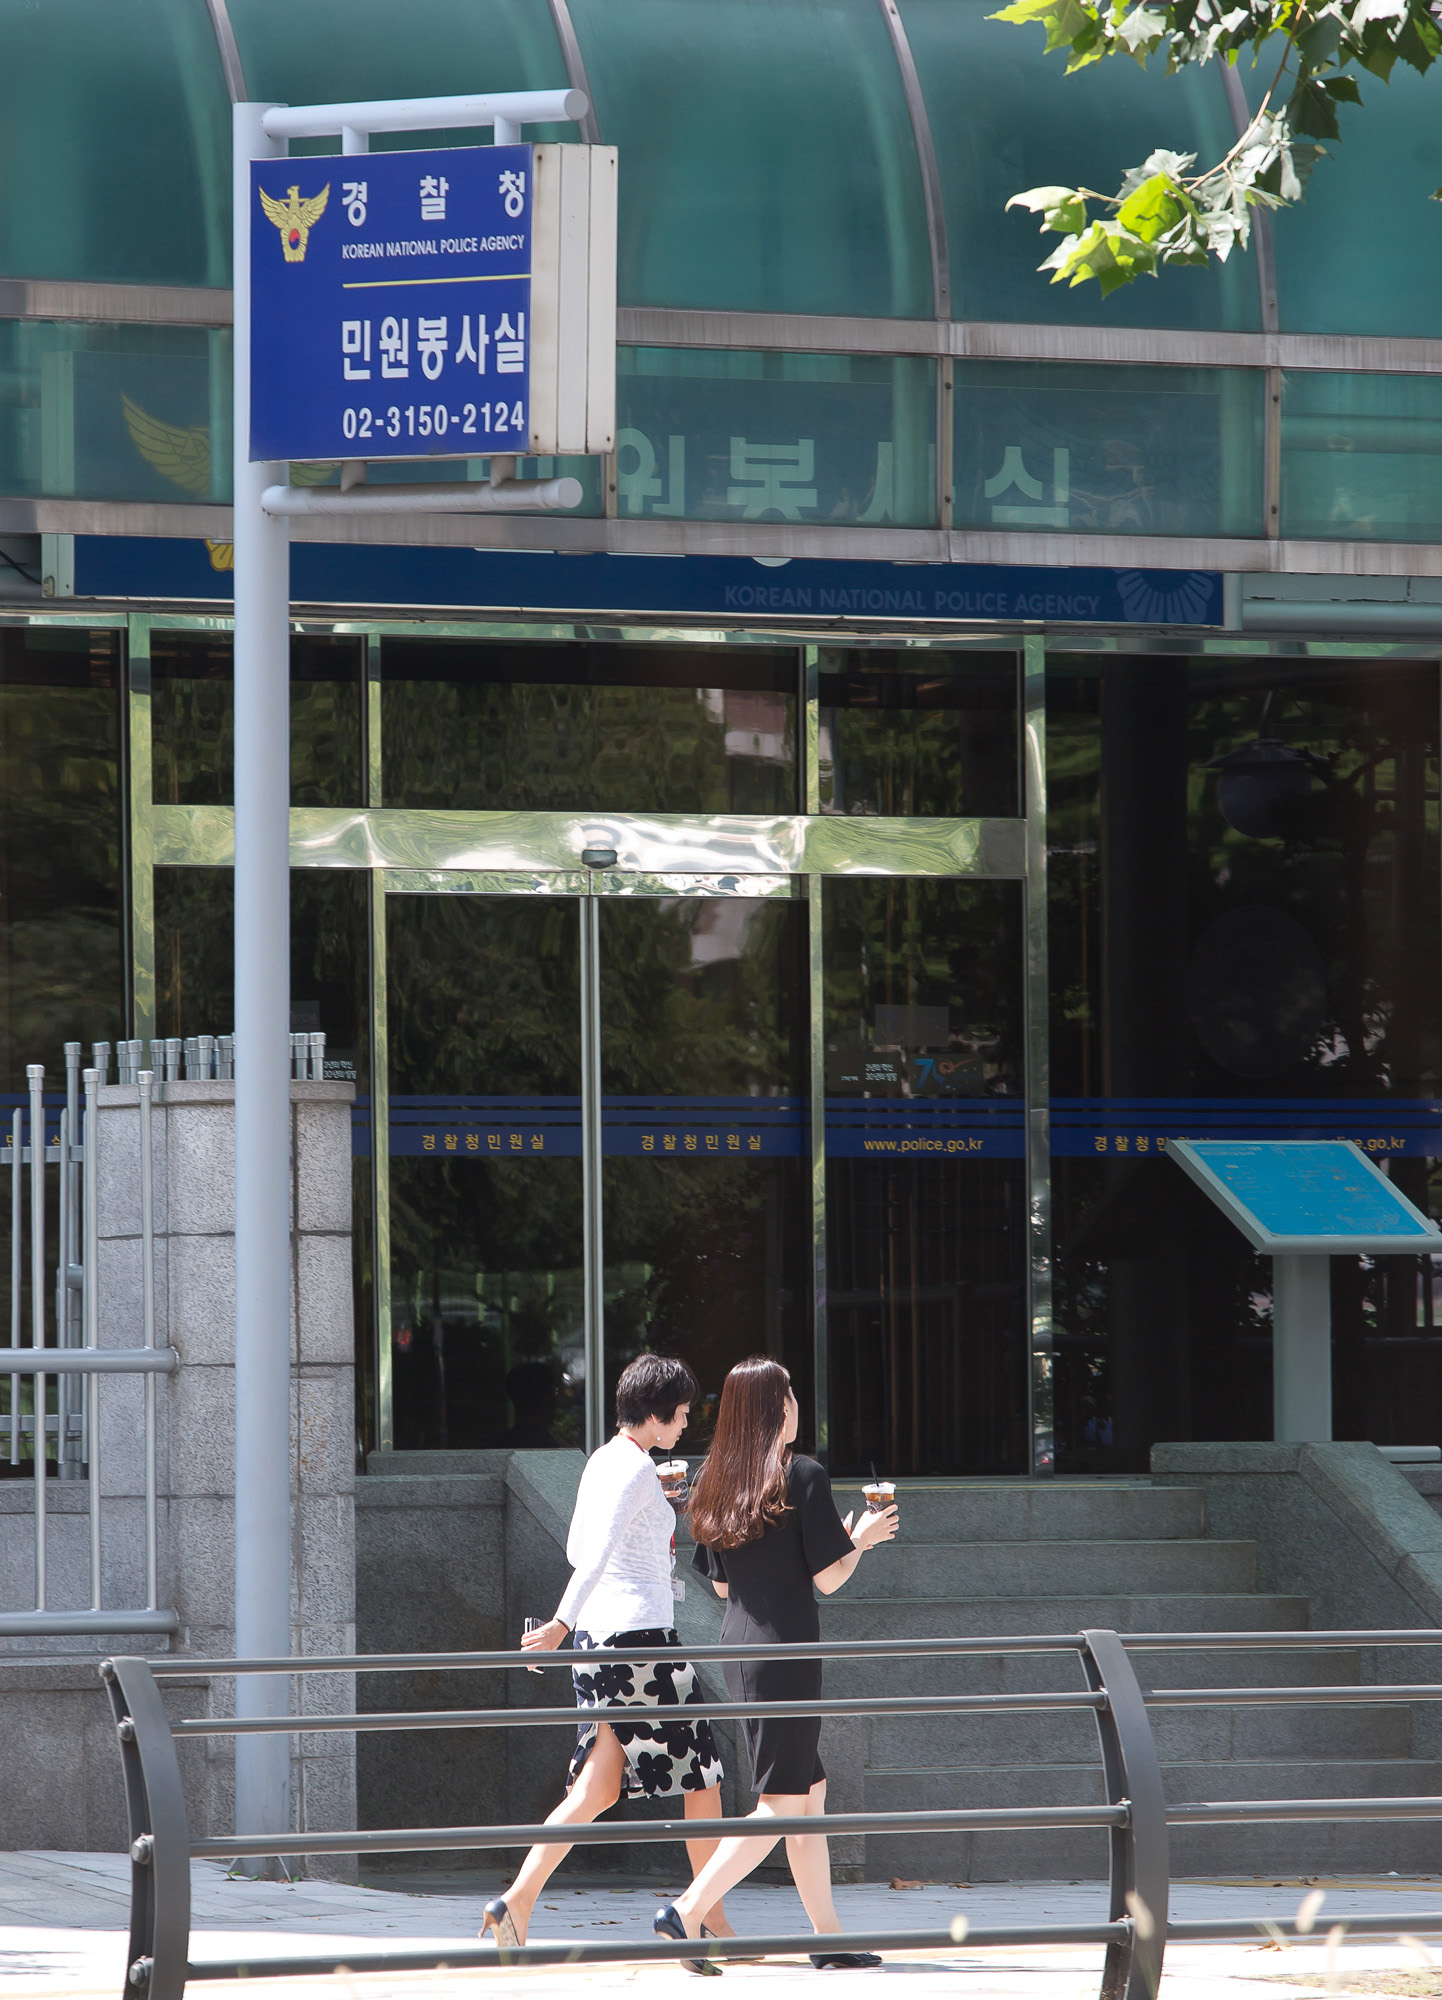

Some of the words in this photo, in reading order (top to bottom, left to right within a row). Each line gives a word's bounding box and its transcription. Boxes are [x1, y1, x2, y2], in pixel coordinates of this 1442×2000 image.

[342, 243, 384, 259] KOREAN
[386, 239, 438, 257] NATIONAL
[440, 237, 478, 254] POLICE
[480, 234, 525, 251] AGENCY
[342, 311, 526, 381] 민원봉사실
[342, 400, 526, 439] 02-3150-2124
[725, 585, 813, 609] KOREAN
[819, 587, 926, 611] NATIONAL
[935, 590, 1007, 613] POLICE
[1014, 593, 1101, 616] AGENCY
[422, 1134, 544, 1150] 경찰청민원실
[641, 1134, 761, 1150] 경찰청민원실
[863, 1137, 983, 1153] www.police.go.kr
